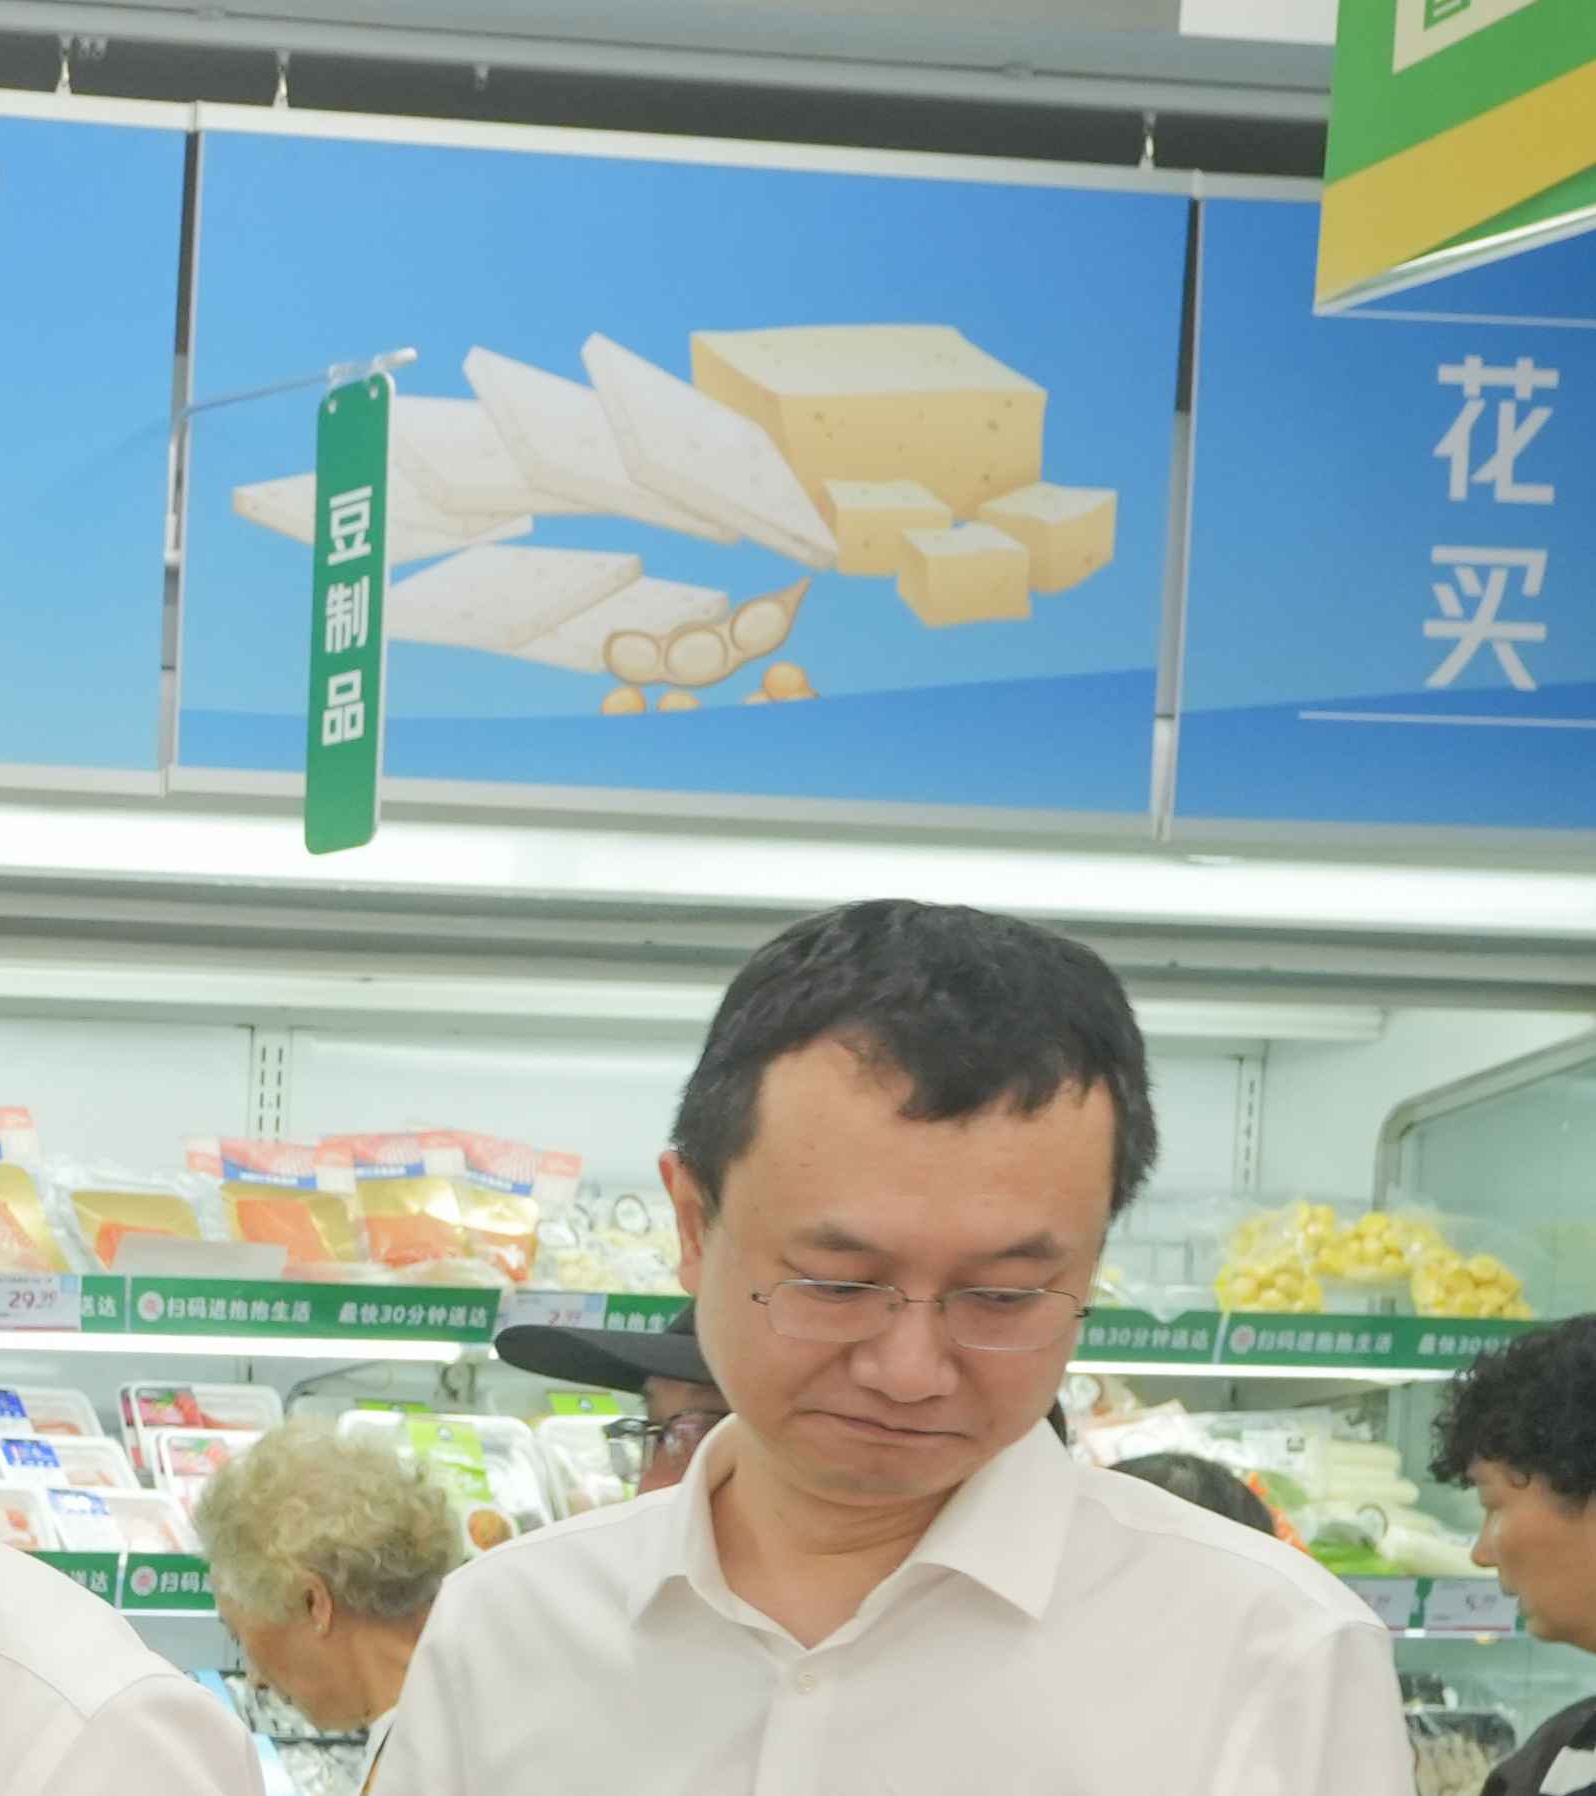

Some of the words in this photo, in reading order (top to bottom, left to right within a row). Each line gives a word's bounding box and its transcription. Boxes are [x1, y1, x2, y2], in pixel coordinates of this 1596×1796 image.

[1432, 355, 1560, 504] 花
[320, 486, 373, 747] 豆制品
[1422, 546, 1549, 692] 买
[166, 1297, 312, 1322] 扫码进抱抱生活
[338, 1301, 488, 1328] 最快30分钟送达
[1079, 1326, 1210, 1351] 快30分钟送达
[1418, 1333, 1506, 1356] 最快30分
